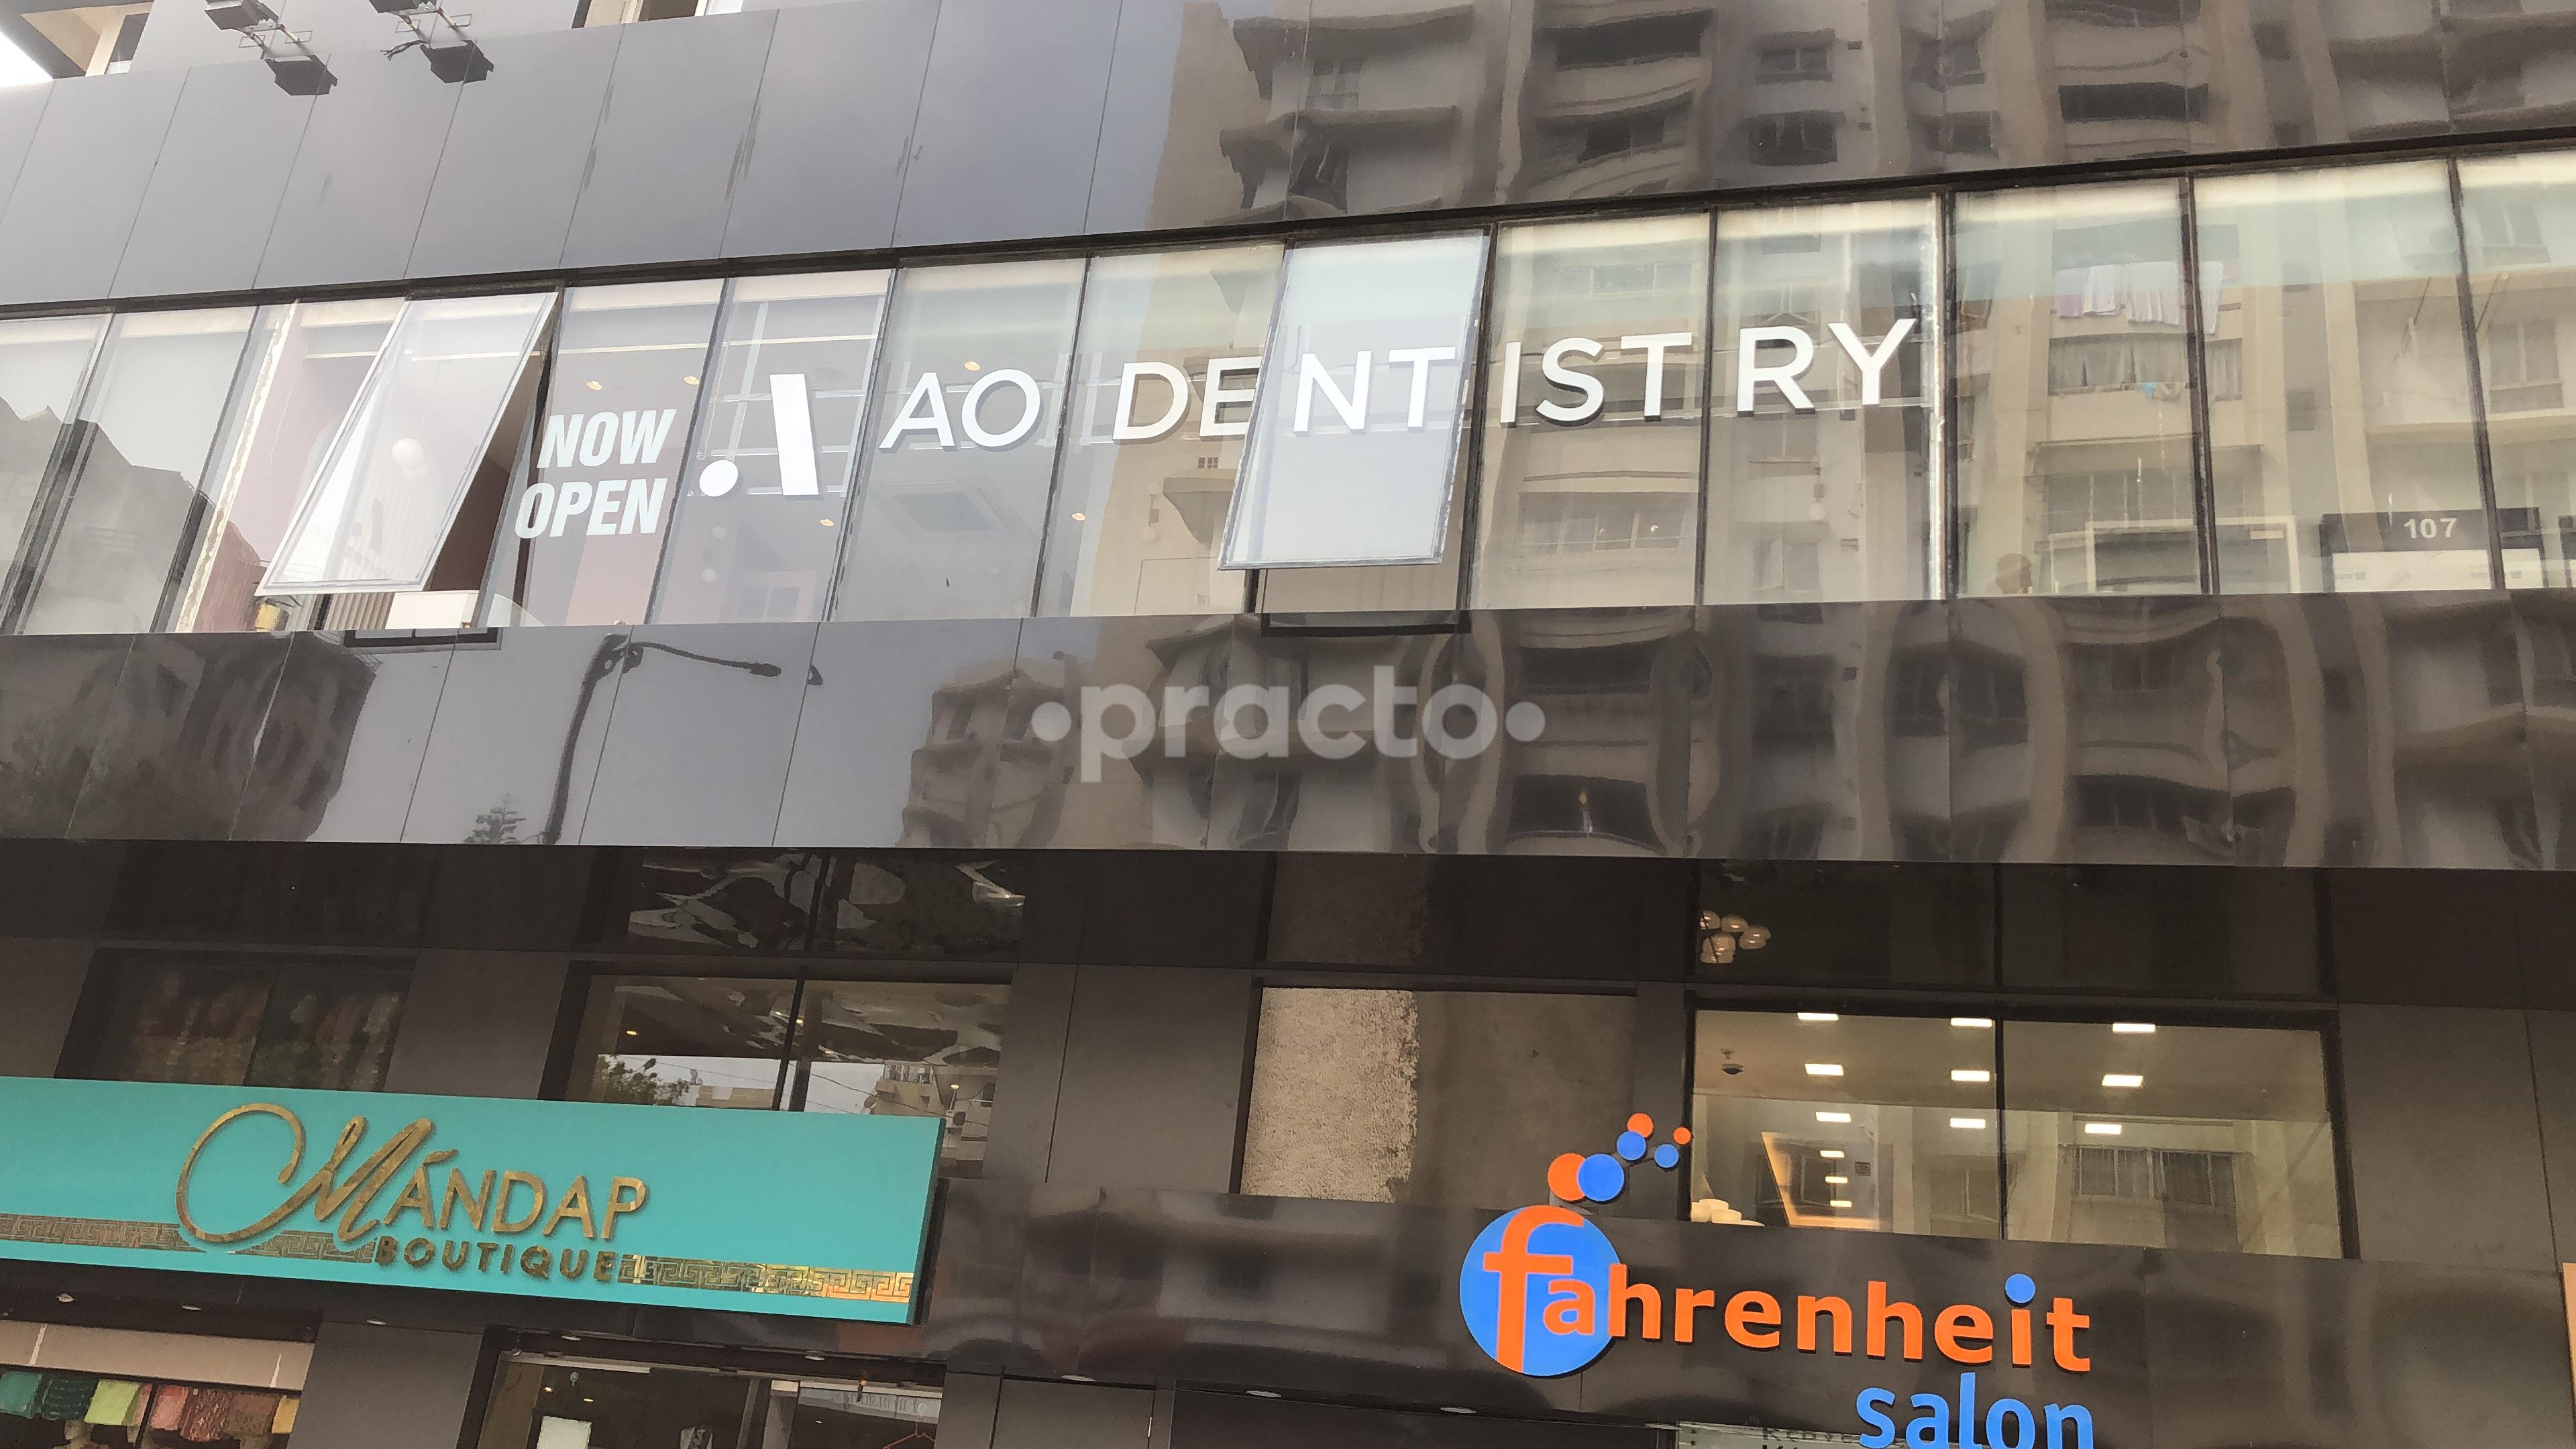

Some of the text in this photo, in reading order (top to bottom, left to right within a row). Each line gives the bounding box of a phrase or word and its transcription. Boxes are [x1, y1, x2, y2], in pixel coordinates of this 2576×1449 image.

[879, 319, 1916, 449] AO DENTISTRY
[537, 409, 678, 470] NOW
[515, 477, 667, 539] OPEN
[2404, 517, 2457, 539] 107
[374, 1235, 616, 1283] BOUTIQUE
[1483, 1204, 2091, 1373] fahrenheit
[1856, 1372, 2094, 1449] salon
